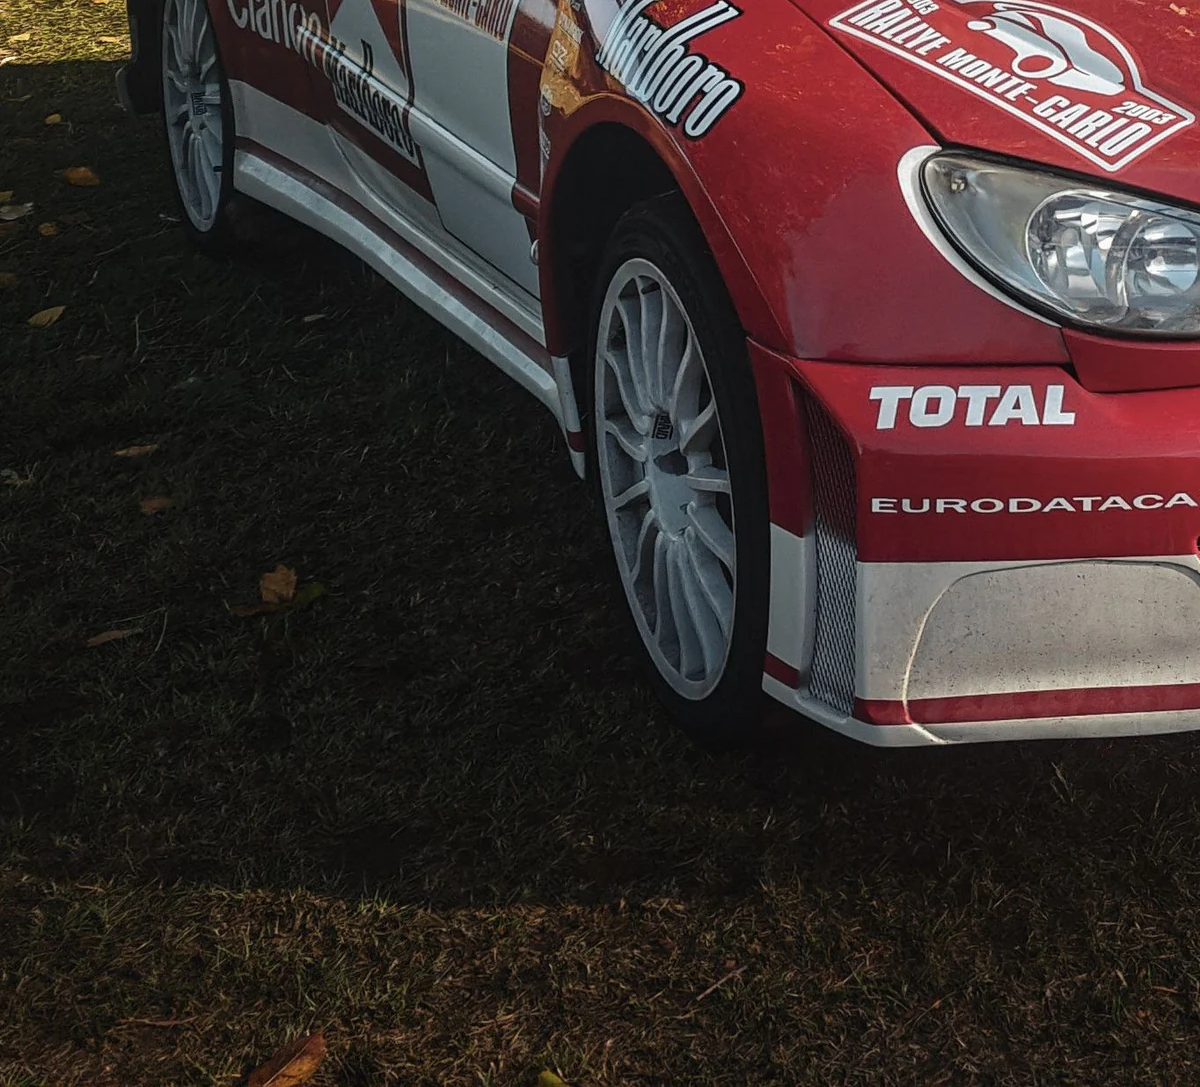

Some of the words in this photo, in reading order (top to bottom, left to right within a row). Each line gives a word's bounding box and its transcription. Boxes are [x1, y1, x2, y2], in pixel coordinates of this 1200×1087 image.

[936, 47, 1153, 157] MONTE-CARLO
[1111, 100, 1177, 125] 2003
[869, 384, 1076, 430] TOTAL
